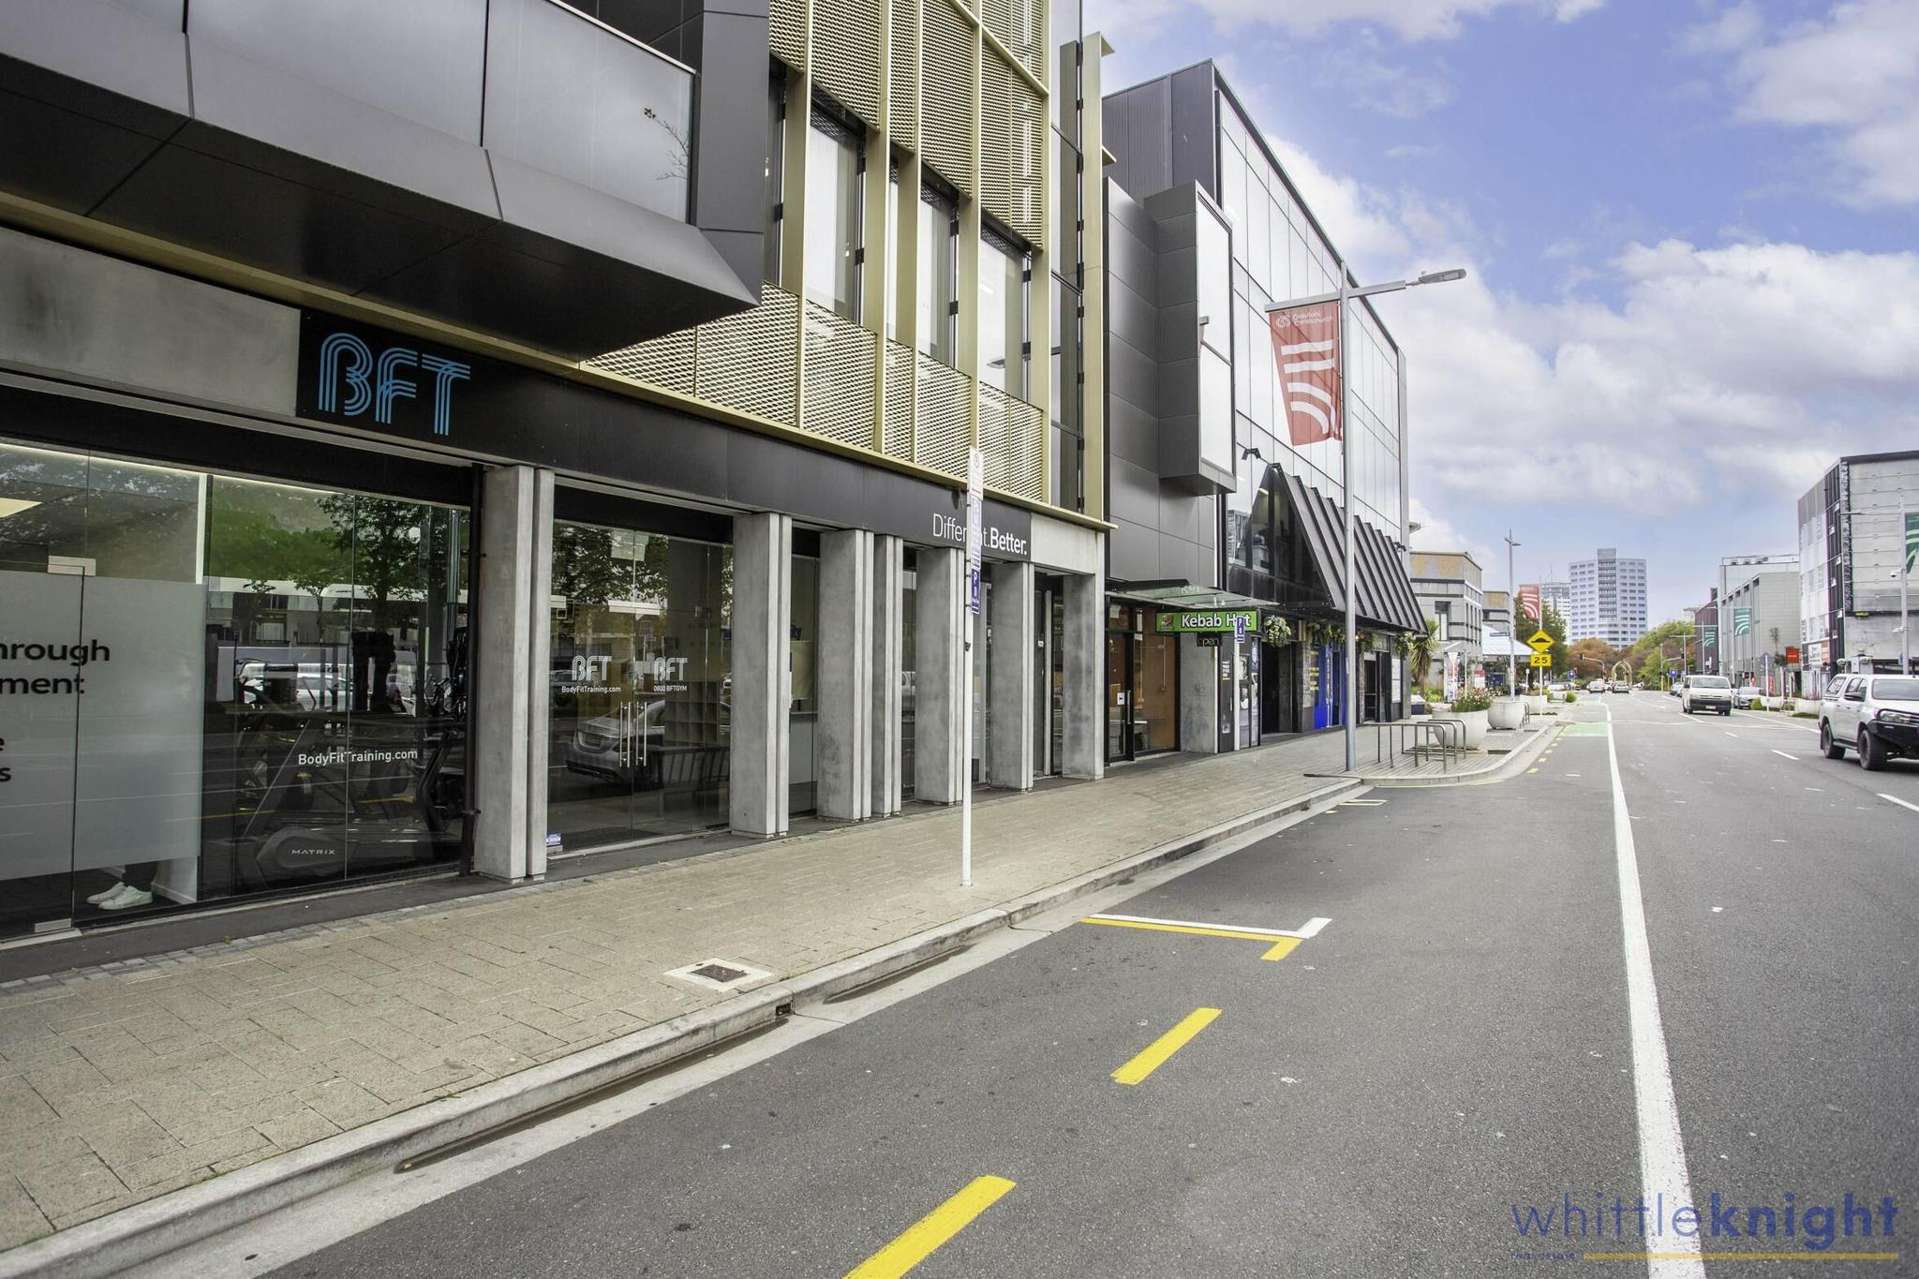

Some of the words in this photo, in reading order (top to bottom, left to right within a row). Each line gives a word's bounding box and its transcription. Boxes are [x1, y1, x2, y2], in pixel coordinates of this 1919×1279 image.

[319, 333, 471, 436] BFT
[933, 513, 1027, 555] Differt.Better.
[1182, 613, 1222, 627] Kebab
[1226, 613, 1250, 627] Ht
[572, 656, 612, 680] BFT
[654, 656, 688, 680] BFT
[1534, 656, 1548, 665] 25
